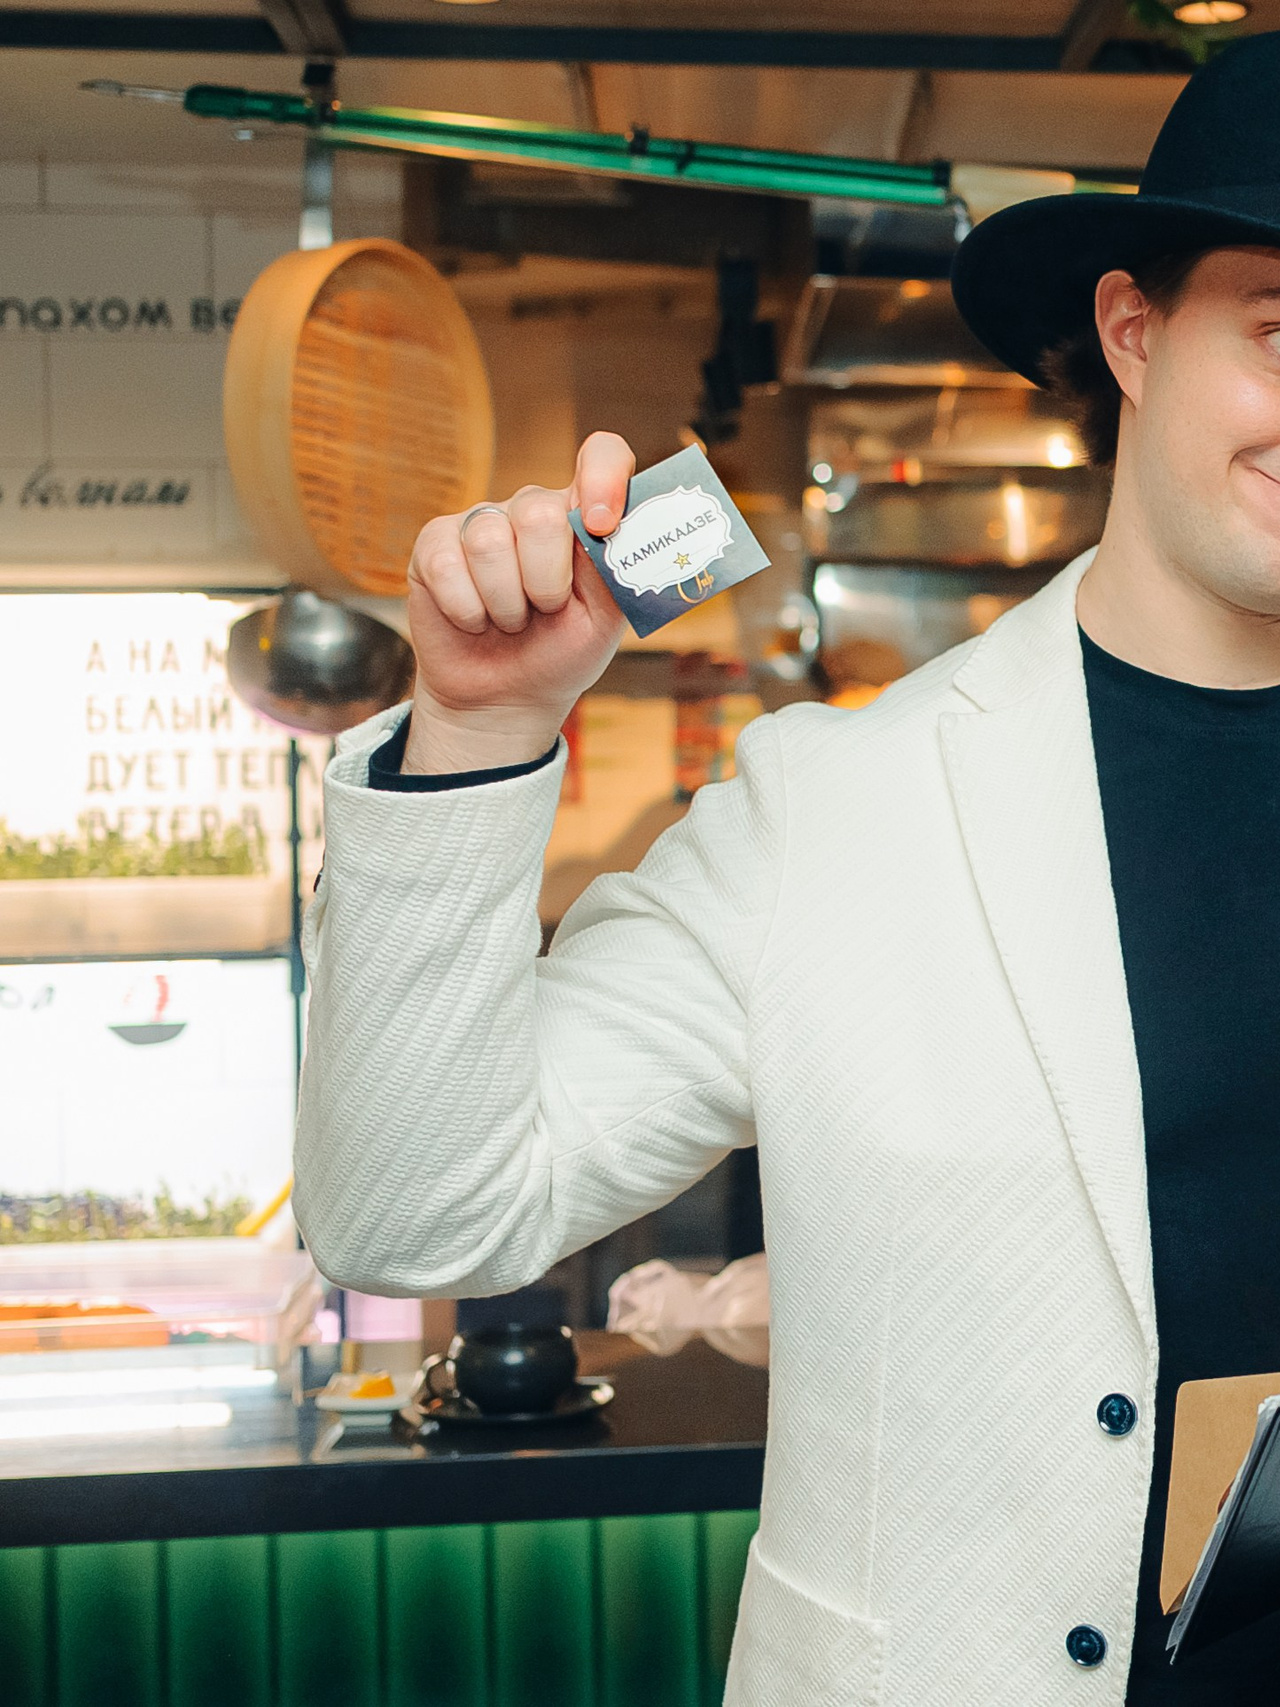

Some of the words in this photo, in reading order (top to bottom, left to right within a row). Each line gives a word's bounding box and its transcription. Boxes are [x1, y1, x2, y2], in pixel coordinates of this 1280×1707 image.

[619, 510, 717, 571] КАМИКАДЗЕ
[86, 639, 106, 673] А
[128, 639, 181, 673] НА
[86, 682, 233, 735] БЕЛЫЙ
[86, 749, 192, 794] ДУЕТ
